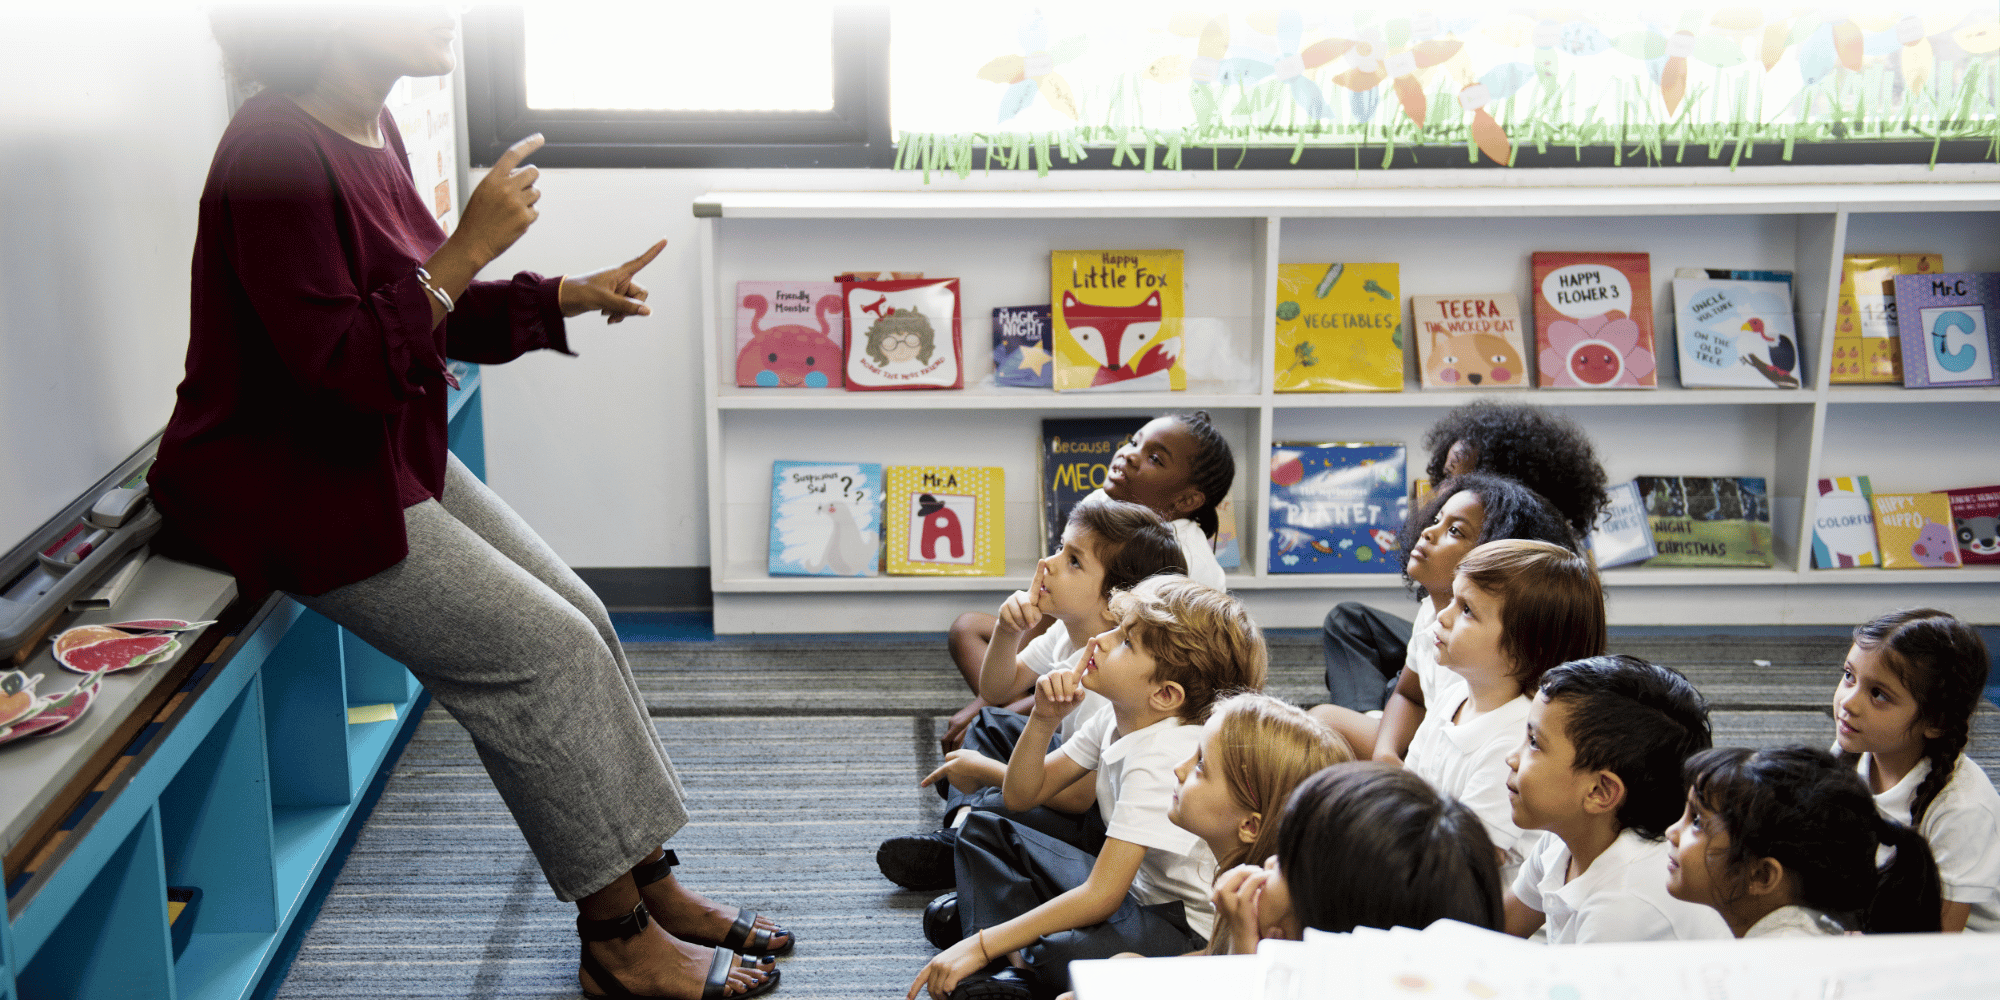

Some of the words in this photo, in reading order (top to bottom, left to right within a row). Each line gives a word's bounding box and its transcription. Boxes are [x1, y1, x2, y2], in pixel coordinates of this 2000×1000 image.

[1102, 252, 1139, 269] Happy
[1072, 265, 1127, 289] Little
[1135, 267, 1168, 289] Fox
[1559, 271, 1601, 288] HAPPY
[775, 290, 811, 304] Friendly
[1557, 285, 1607, 304] FLOWER
[1611, 285, 1620, 299] 3
[1692, 291, 1726, 313] UNCLE
[775, 303, 811, 313] Monster
[1436, 300, 1501, 319] TEERA
[999, 310, 1040, 325] MAGIC
[1303, 313, 1393, 329] VEGETABLES
[1002, 322, 1044, 337] NIGHT
[1424, 321, 1443, 333] THE
[1447, 320, 1491, 333] WICKED
[1493, 319, 1515, 332] CAT
[1694, 330, 1709, 343] ON
[1713, 335, 1730, 348] THE
[1699, 342, 1722, 356] OLD
[1696, 352, 1722, 366] TREE
[1053, 435, 1111, 453] Because
[793, 472, 839, 484] Suspicious
[1053, 463, 1109, 492] MEO
[807, 483, 827, 494] Seal
[1286, 501, 1382, 526] PLANET
[1817, 514, 1873, 529] COLORFU
[1882, 512, 1923, 529] HIPPO
[1655, 520, 1692, 534] NIGHT
[1657, 541, 1726, 557] CHRISTMAS
